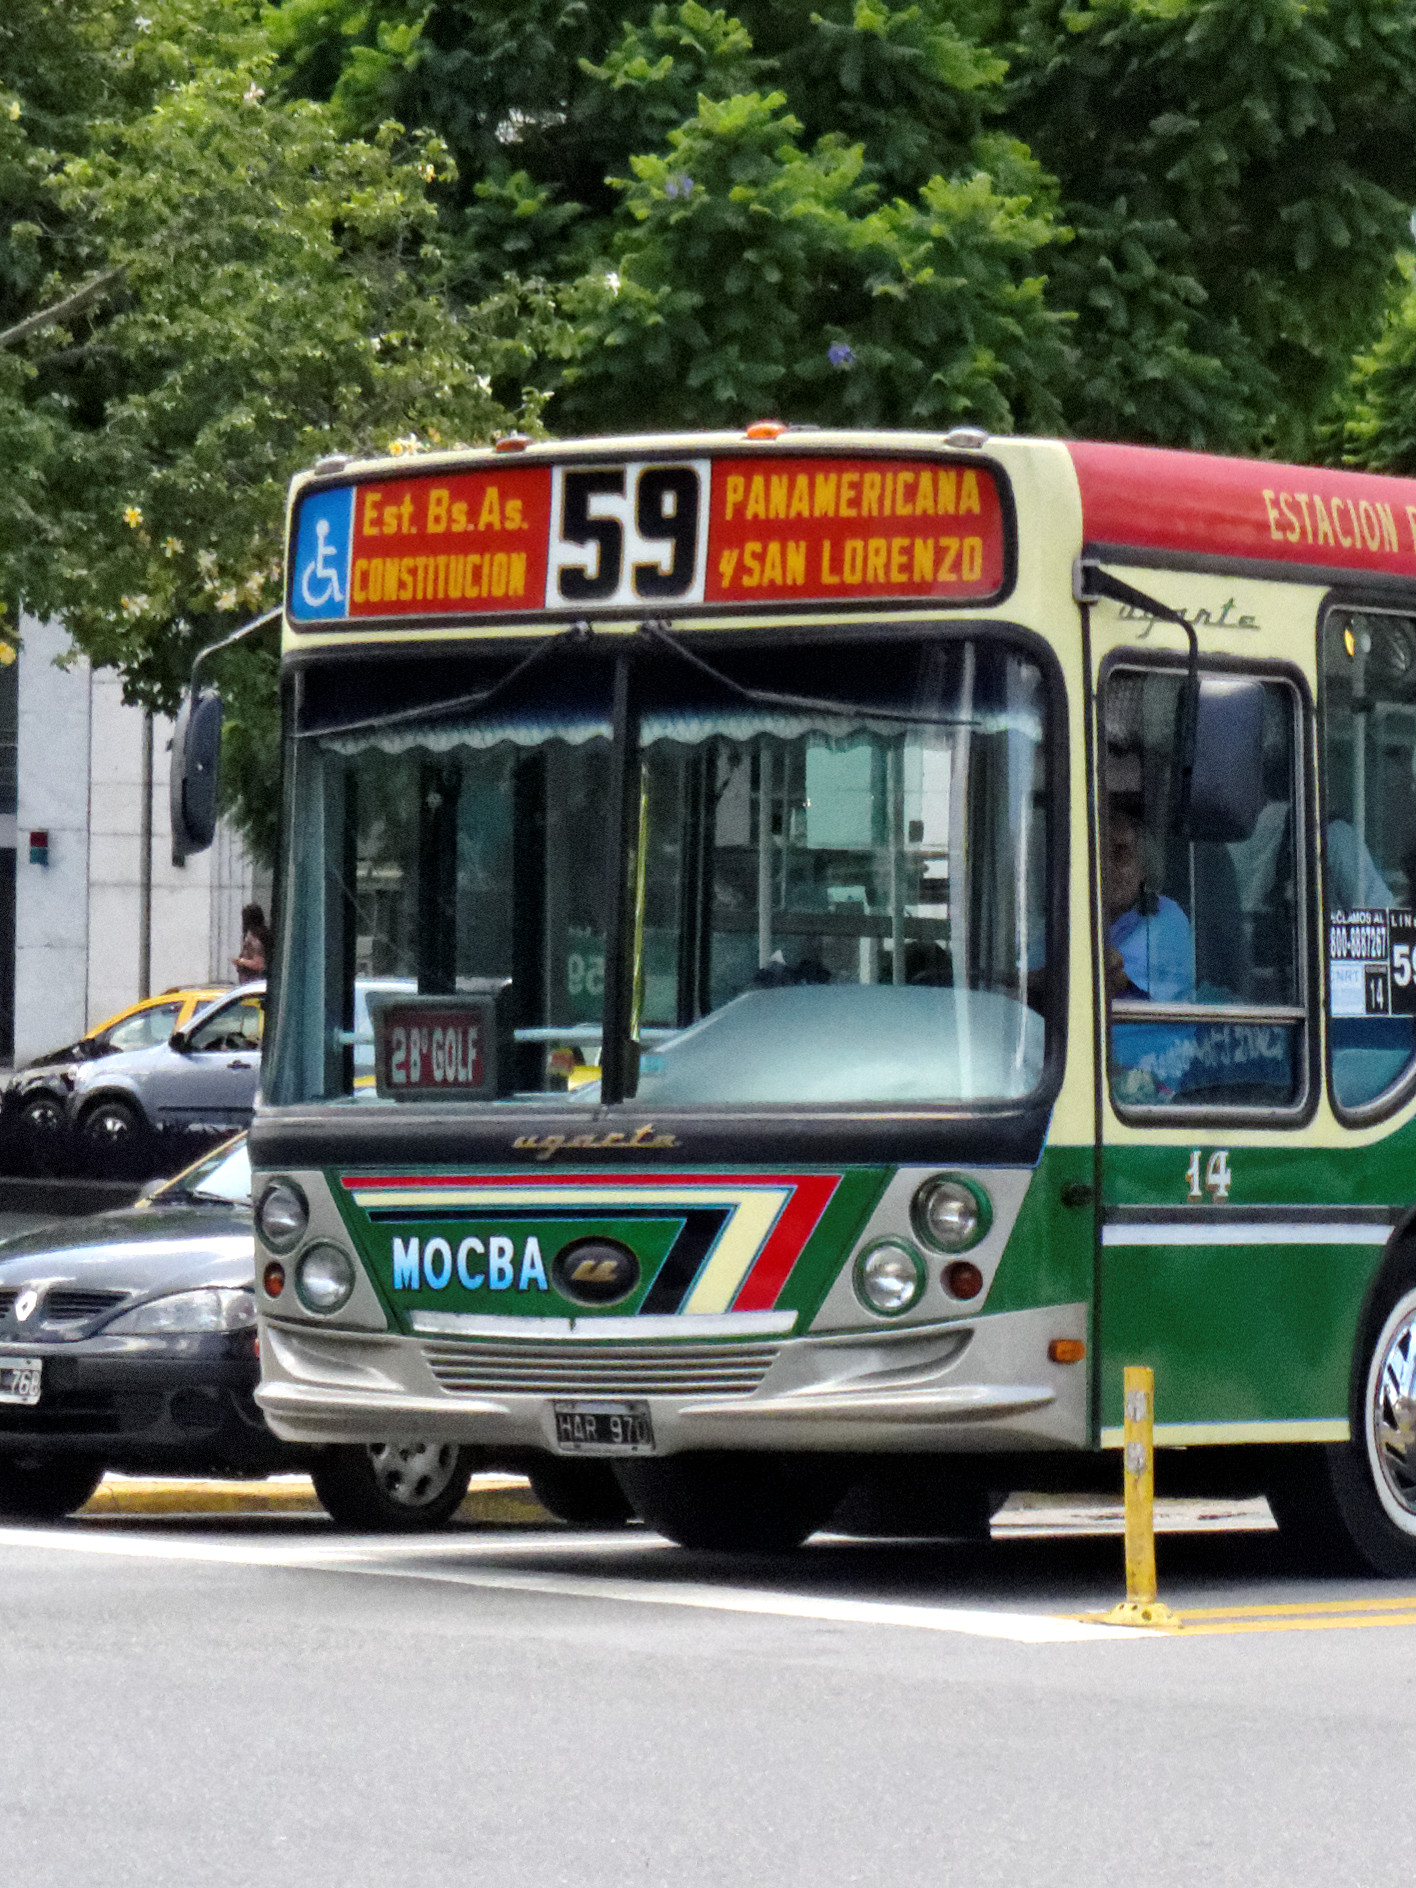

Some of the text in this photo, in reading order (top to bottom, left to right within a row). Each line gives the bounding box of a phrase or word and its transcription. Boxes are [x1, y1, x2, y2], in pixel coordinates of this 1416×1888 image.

[362, 491, 417, 536] Est.
[725, 468, 981, 521] PANAMERICANA
[1262, 488, 1399, 553] ESTACION
[556, 464, 701, 602] 59
[353, 551, 527, 604] CONSTITUCION
[741, 540, 806, 588] SAN
[820, 536, 983, 585] LORENZO
[1369, 977, 1384, 1010] 14
[432, 1026, 478, 1083] GOLF
[1185, 1149, 1232, 1202] 14
[392, 1236, 549, 1291] MOCBA
[558, 1414, 598, 1441] HAR
